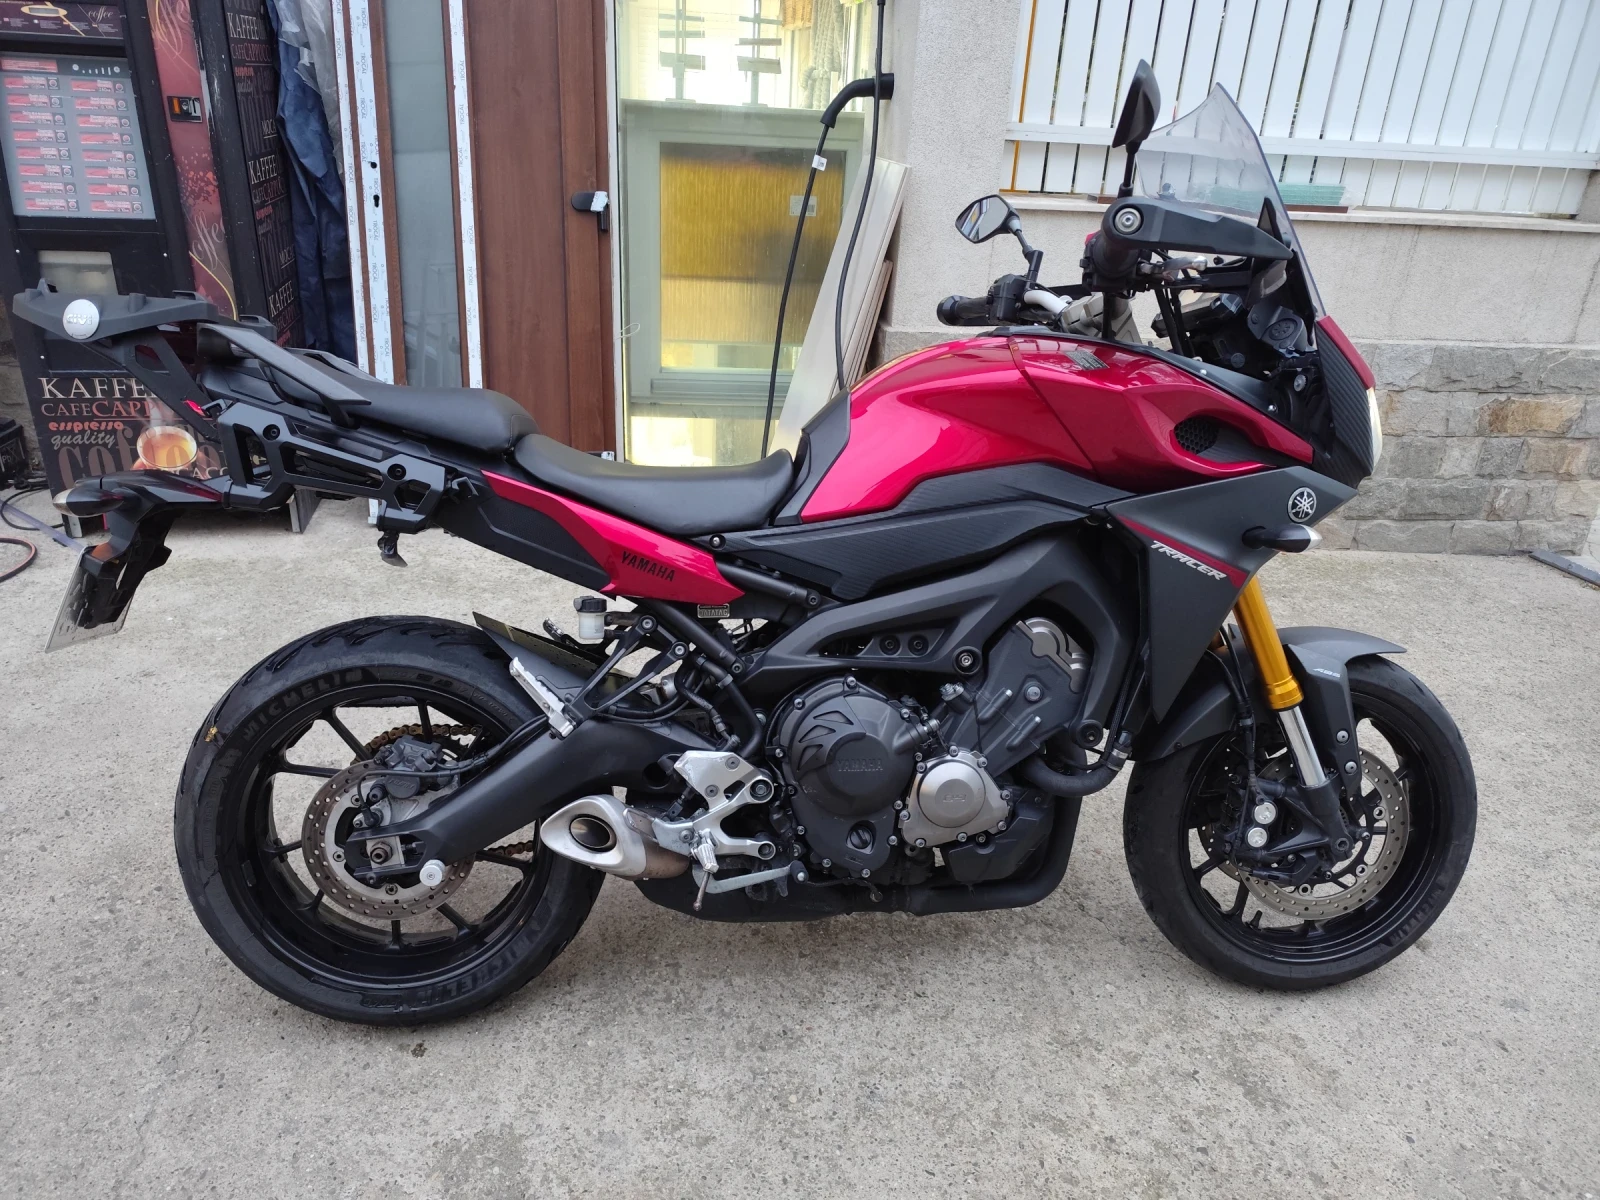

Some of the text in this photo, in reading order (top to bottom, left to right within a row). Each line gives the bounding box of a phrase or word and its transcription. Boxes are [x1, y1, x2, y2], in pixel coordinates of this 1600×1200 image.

[88, 6, 114, 23] coffee
[227, 12, 259, 40] KAFFEE
[248, 154, 277, 184] KAFFEE
[269, 280, 295, 317] KAFFEE
[38, 377, 157, 399] KAFFE
[49, 421, 124, 432] esspresso
[51, 430, 115, 450] quality
[621, 550, 675, 583] YAMAHA
[1150, 540, 1227, 581] TRACER
[242, 668, 363, 743] MICHELIN
[836, 758, 885, 773] YAMAHA
